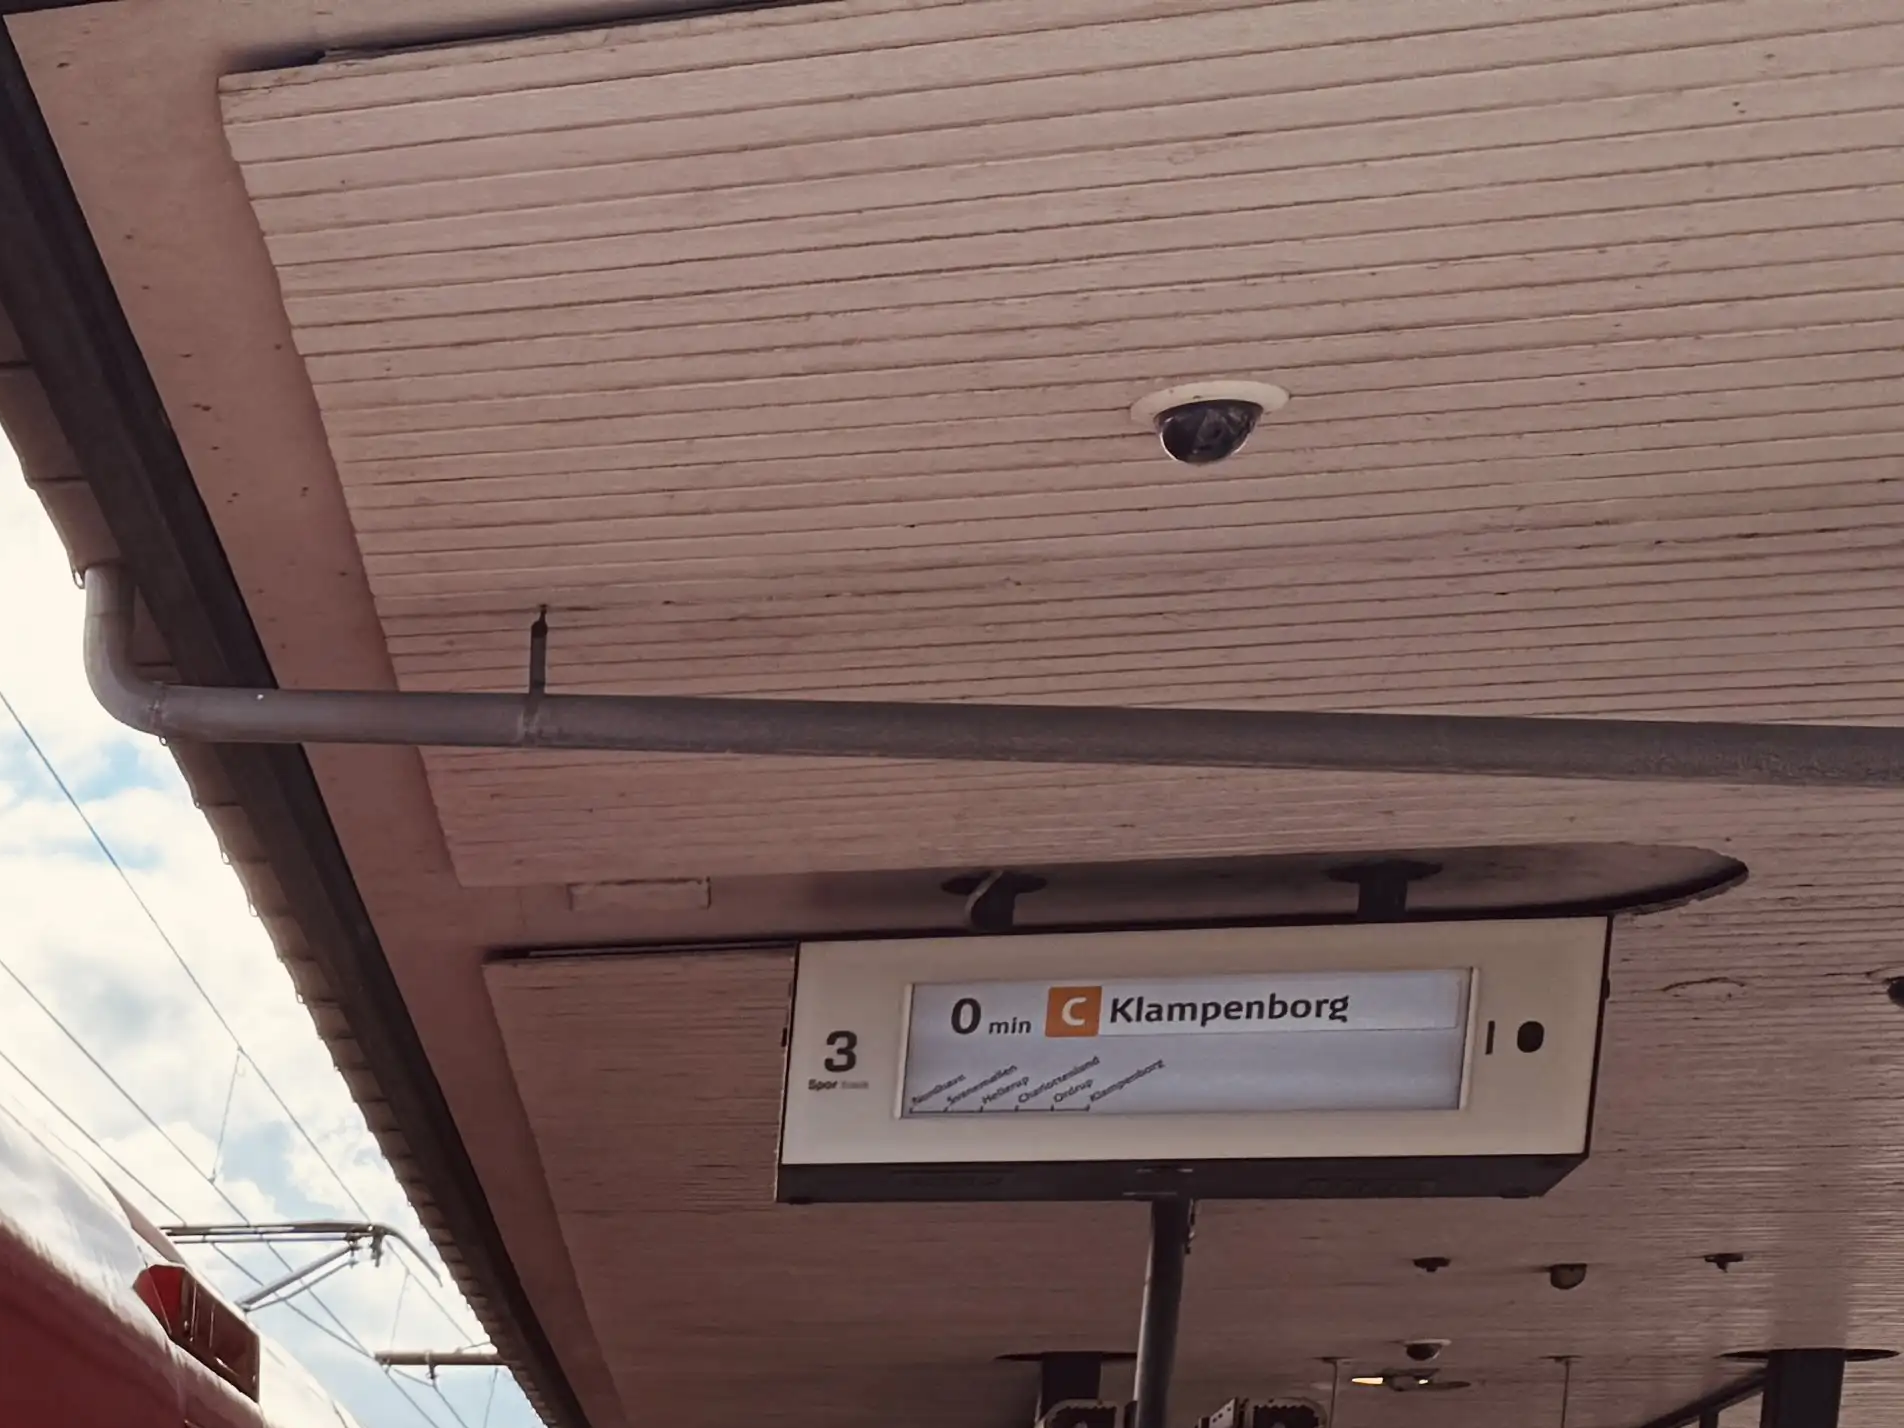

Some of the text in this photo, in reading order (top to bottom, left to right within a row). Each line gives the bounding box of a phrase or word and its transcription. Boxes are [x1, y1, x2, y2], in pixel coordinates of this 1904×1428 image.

[951, 993, 1350, 1035] 0 min C Klampenborg
[824, 1030, 858, 1073] 3
